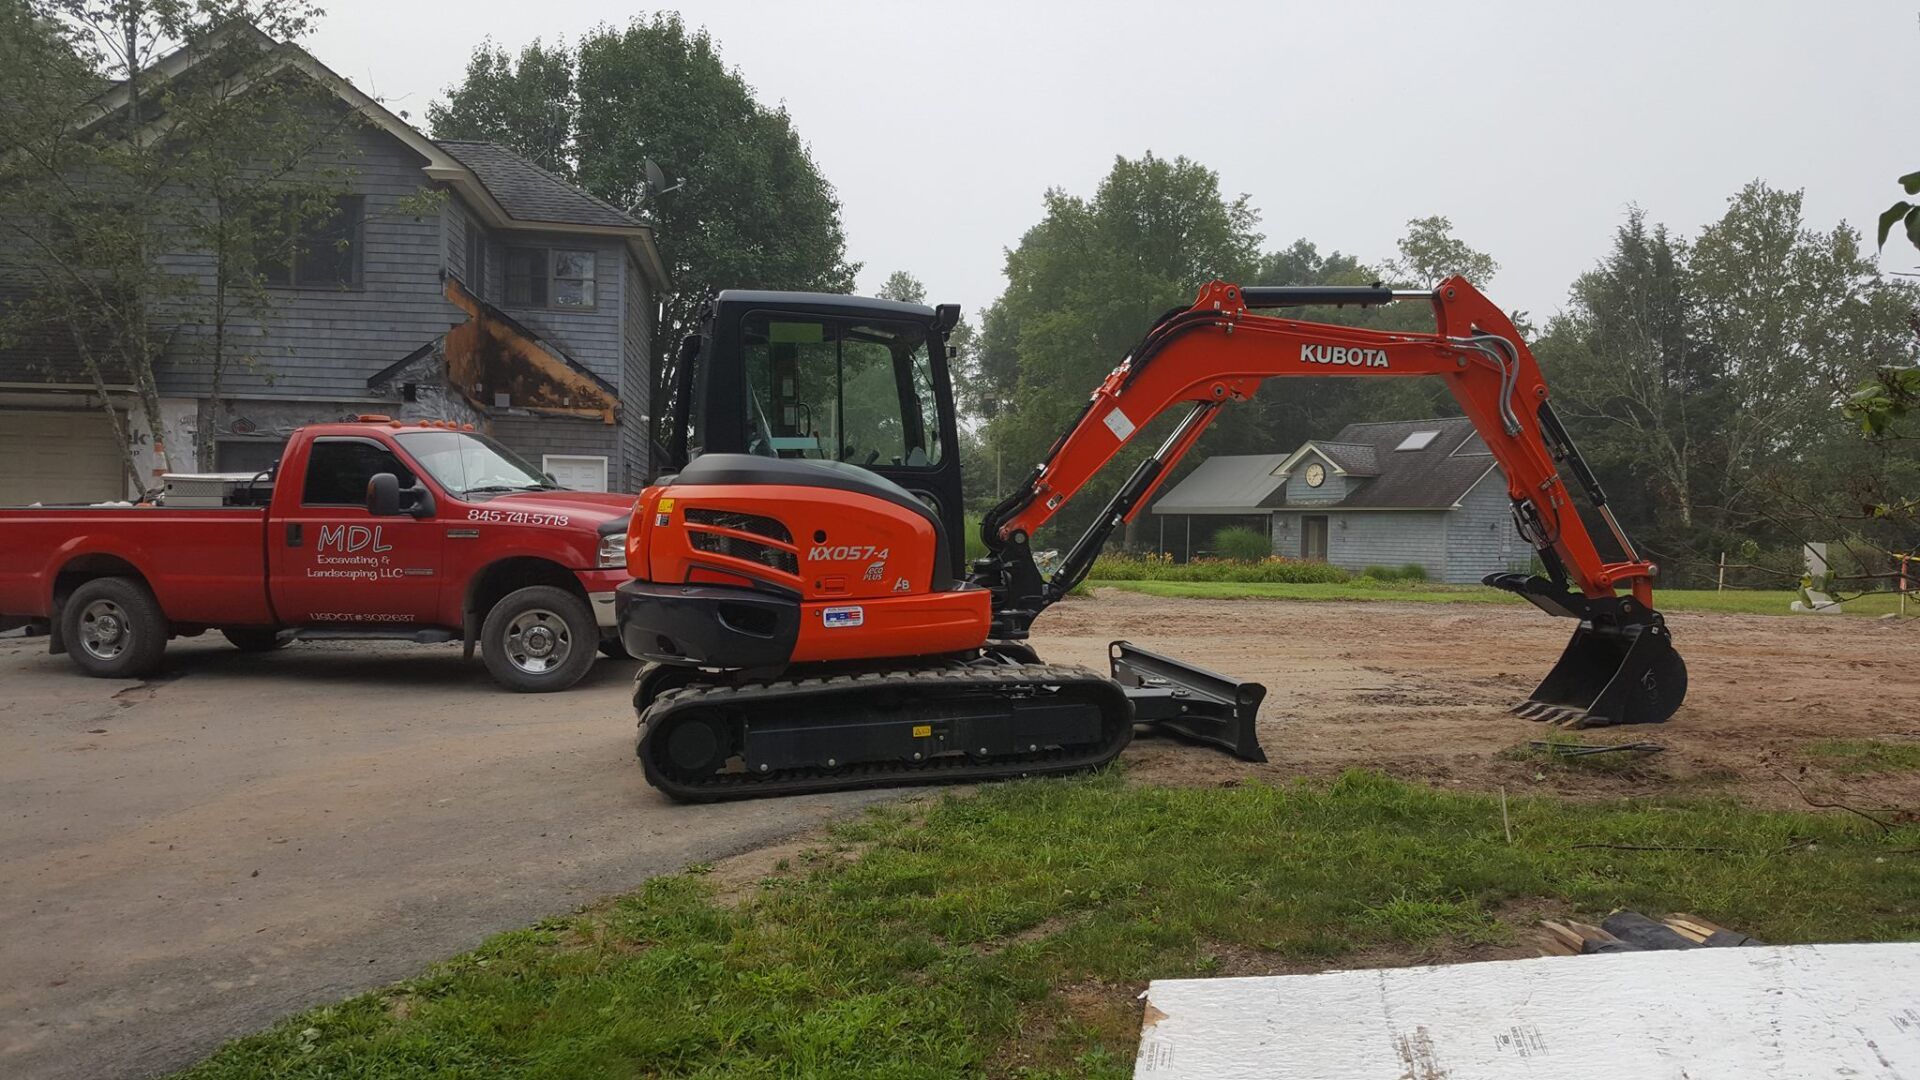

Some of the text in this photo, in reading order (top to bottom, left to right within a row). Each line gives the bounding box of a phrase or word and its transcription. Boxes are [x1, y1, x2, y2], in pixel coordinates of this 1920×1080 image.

[1300, 344, 1389, 368] KUBOTA
[467, 509, 569, 526] 845-741-5713
[318, 525, 392, 552] MDL
[317, 554, 390, 567] Excavating &
[307, 567, 377, 581] Landscaping
[380, 568, 403, 578] LLC
